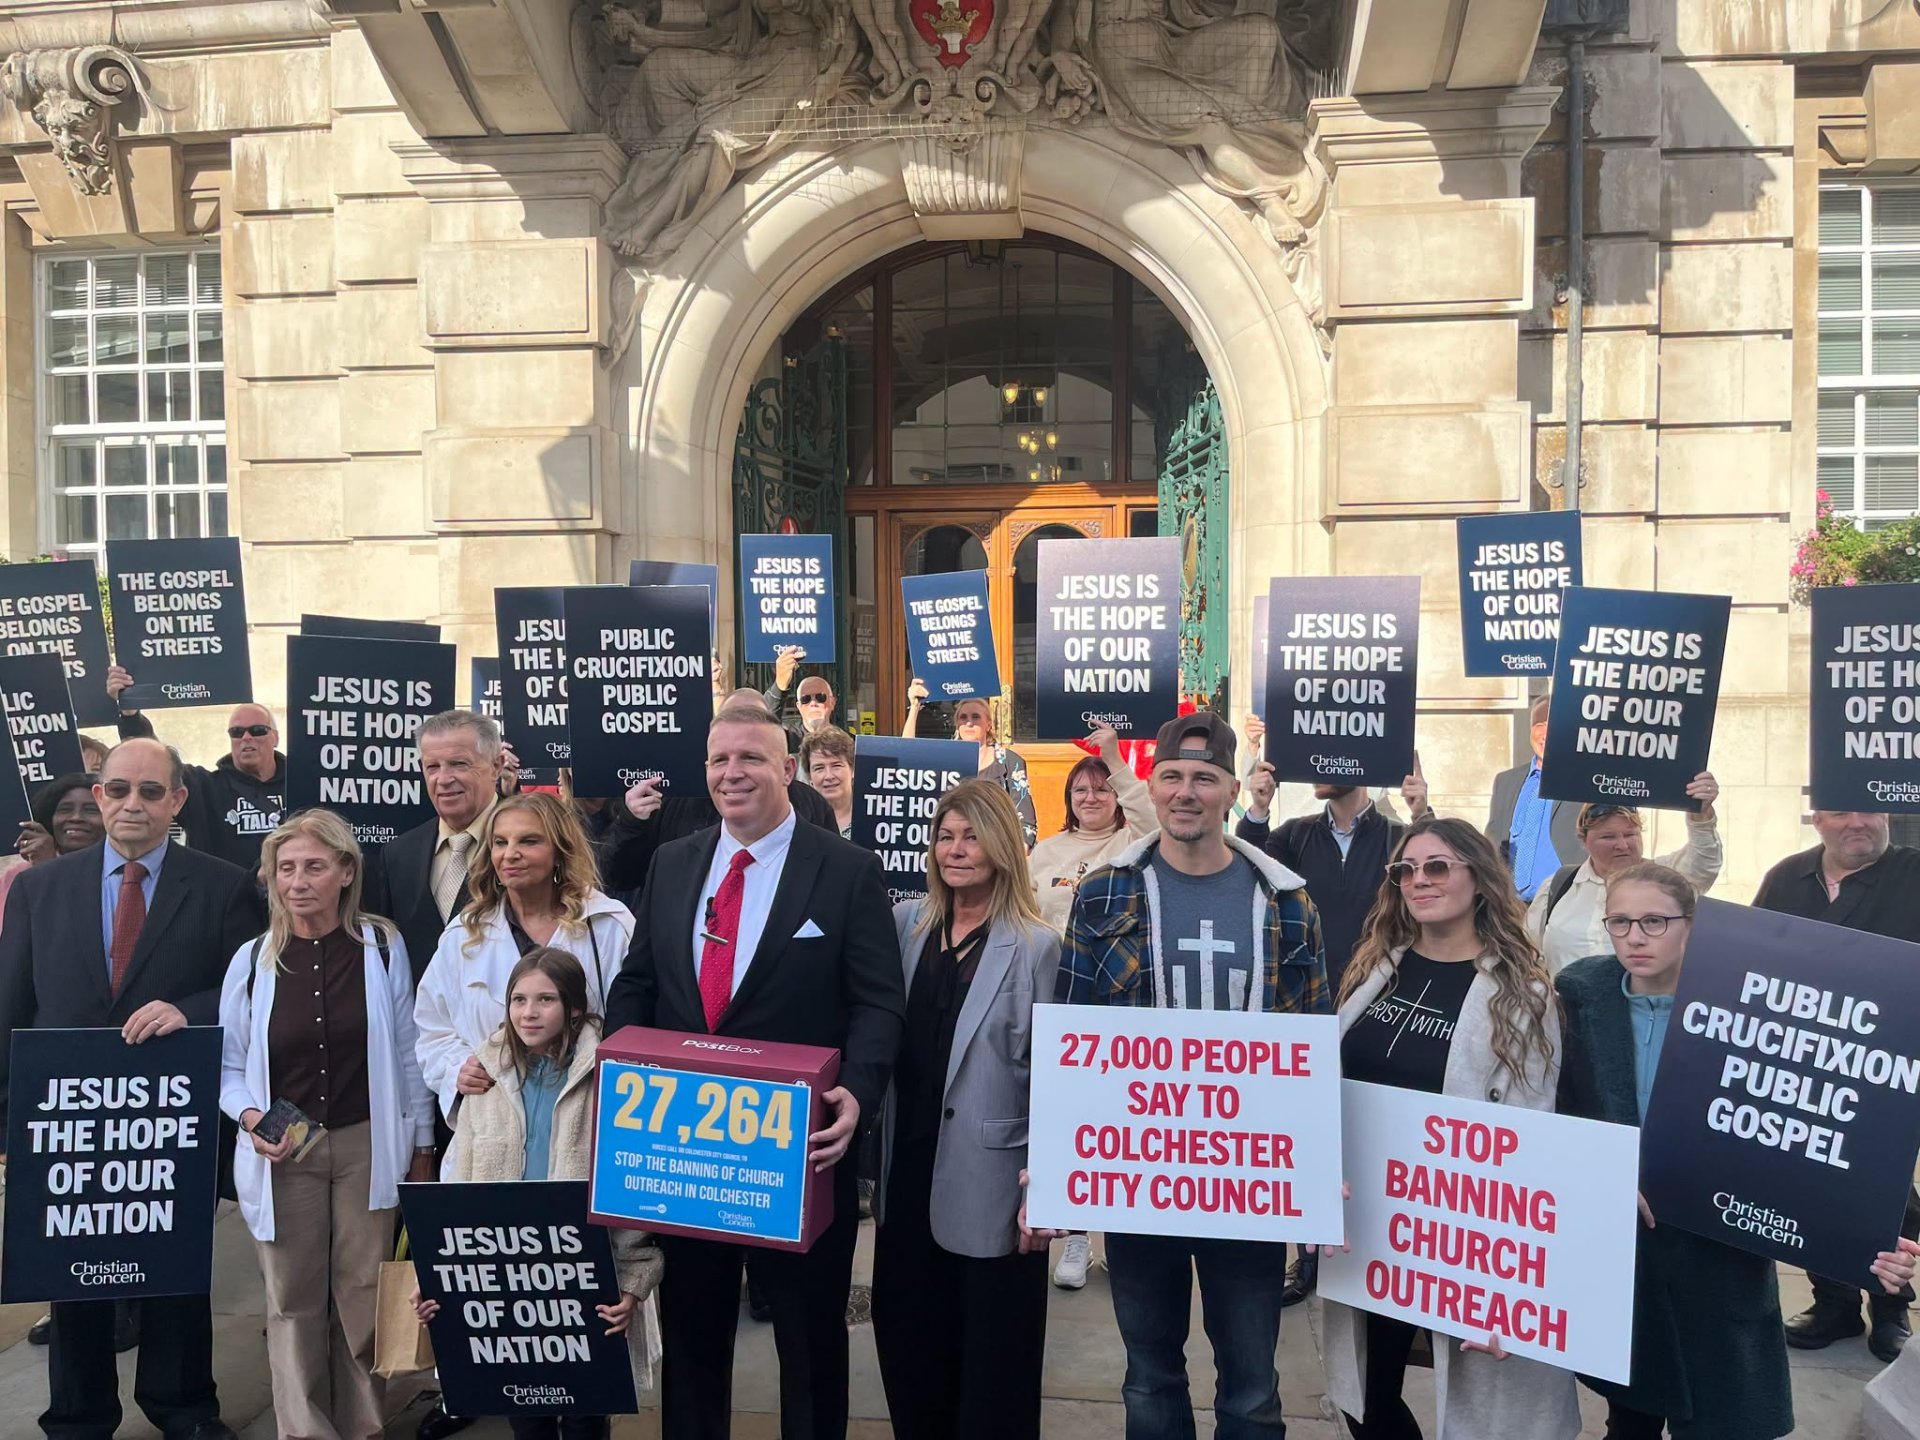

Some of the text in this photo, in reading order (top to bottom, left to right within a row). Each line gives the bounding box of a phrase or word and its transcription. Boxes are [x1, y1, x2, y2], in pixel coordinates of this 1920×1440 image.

[754, 558, 820, 574] JESUS IS
[1474, 542, 1564, 566] JESUS IS
[118, 570, 233, 591] THE GOSPEL
[750, 578, 825, 594] THE HOPE
[1056, 574, 1159, 599] JESUS IS
[1469, 567, 1571, 591] THE HOPE
[18, 594, 92, 616] GOSPEL
[134, 592, 222, 613] BELONGS
[760, 597, 816, 614] OF OUR
[909, 596, 983, 615] THE GOSPEL
[1484, 594, 1559, 616] OF OUR
[0, 616, 82, 639] BELONGS
[146, 615, 215, 634] ON THE
[514, 619, 565, 641] JESU
[761, 617, 817, 633] NATION
[920, 614, 977, 631] BELONGS
[1050, 605, 1166, 631] THE HOPE
[1288, 613, 1397, 639] JESUS IS
[1485, 619, 1560, 641] NATION
[8, 639, 76, 656] ON THE
[141, 636, 222, 657] STREETS
[600, 628, 674, 650] PUBLIC
[929, 631, 973, 647] ON THE
[1064, 637, 1151, 662] OF OUR
[1579, 627, 1702, 660] JESUS IS
[510, 648, 551, 670] THE
[574, 656, 704, 678] CRUCIFIXION
[927, 647, 979, 664] STREETS
[1280, 645, 1328, 670] THE
[1333, 646, 1403, 672] HOPE
[1502, 654, 1541, 664] Christian
[526, 676, 553, 698] OF
[942, 682, 970, 690] Christian
[1064, 668, 1150, 693] NATION
[1570, 659, 1705, 694] THE HOPE
[1826, 661, 1885, 689] THE
[161, 683, 205, 694] Christian
[168, 690, 210, 699] Concern
[310, 676, 432, 706] JESUS IS
[603, 684, 677, 706] PUBLIC
[1295, 678, 1385, 704] OF OUR
[1081, 711, 1127, 722] Christian
[1582, 695, 1682, 727] OF OUR
[1845, 696, 1885, 723] OF
[303, 710, 434, 739] THE HOP
[602, 712, 681, 733] GOSPEL
[1293, 710, 1384, 737] NATION
[1576, 727, 1679, 760] NATION
[1845, 732, 1920, 759] NATI
[320, 744, 421, 772] OF OUR
[1310, 754, 1359, 767] Christian
[1316, 764, 1363, 776] Concern
[617, 768, 664, 779] Christian
[870, 767, 960, 792] JESUS IS
[1593, 774, 1645, 788] Christian
[320, 778, 420, 805] NATION
[1599, 784, 1649, 797] Concern
[1876, 790, 1920, 802] Conce
[864, 795, 939, 819] THE HO
[350, 823, 394, 836] hristian
[876, 822, 931, 846] OF OU
[1739, 971, 1880, 1035] PUBLIC
[1410, 1014, 1454, 1040] WITH
[1059, 1033, 1312, 1077] 27,000 PEOPLE
[1682, 1001, 1920, 1094] CRUCIFIXION
[38, 1075, 191, 1111] JESUS IS
[1127, 1080, 1240, 1120] SAY TO
[1719, 1054, 1859, 1122] PUBLIC
[613, 1071, 793, 1149] 27,264
[28, 1116, 199, 1153] THE HOPE
[1423, 1114, 1519, 1167] STOP
[1707, 1097, 1850, 1170] GOSPEL
[1074, 1124, 1294, 1169] COLCHESTER
[48, 1159, 175, 1195] OF OUR
[615, 1151, 784, 1188] STOP THE BANNING OF CHURCH
[624, 1175, 770, 1209] OUTREACH IN COLCHESTER
[1067, 1170, 1302, 1217] CITY COUNCIL
[1385, 1158, 1556, 1234] BANNING
[46, 1200, 174, 1238] NATION
[718, 1210, 752, 1221] Christian
[723, 1218, 755, 1229] Concern
[1713, 1191, 1798, 1232] Christian
[438, 1225, 583, 1256] JESUS IS
[1722, 1208, 1804, 1249] Concern
[1388, 1212, 1546, 1289] CHURCH
[70, 1261, 139, 1276] Christian
[80, 1272, 145, 1286] Concern
[433, 1262, 599, 1293] THE HOPE
[463, 1299, 585, 1328] OF OUR
[1366, 1259, 1568, 1353] OUTREACH
[469, 1335, 591, 1364] NATION
[503, 1385, 566, 1397] Christian
[514, 1394, 574, 1405] Concern
